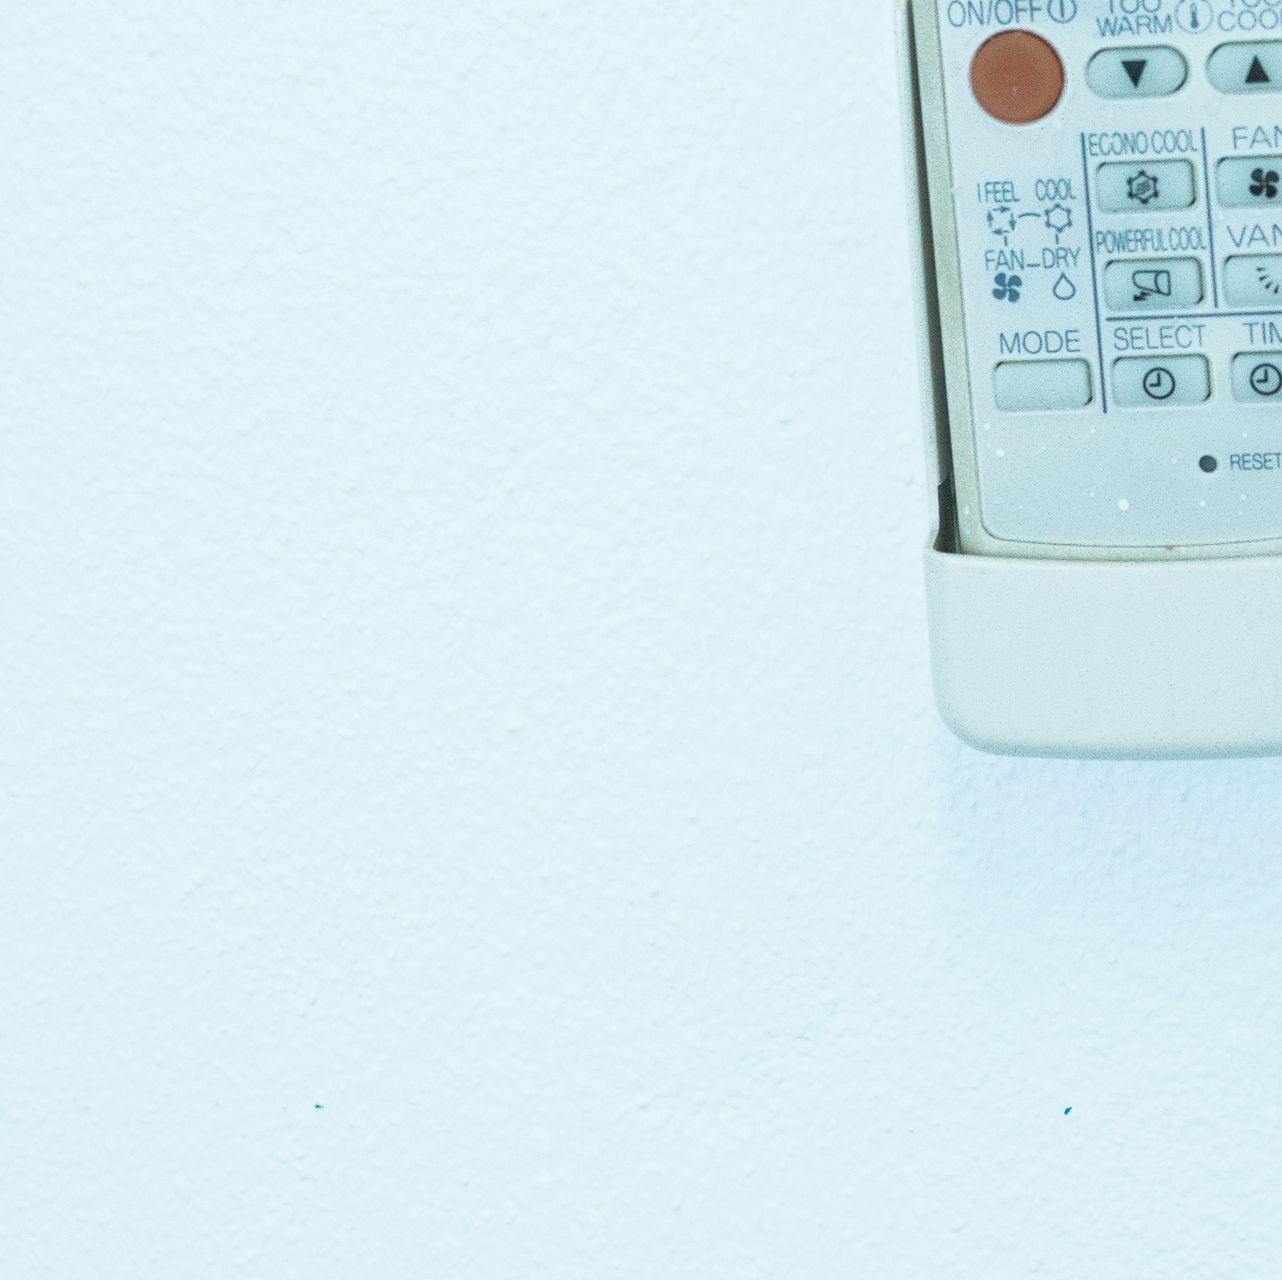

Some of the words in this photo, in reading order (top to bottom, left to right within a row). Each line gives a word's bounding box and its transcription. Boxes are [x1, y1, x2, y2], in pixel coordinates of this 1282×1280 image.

[1096, 14, 1174, 37] WARM
[1035, 178, 1079, 201] COOL
[999, 329, 1081, 355] MODE
[1113, 324, 1208, 351] SELECT
[1229, 452, 1282, 471] RESET
